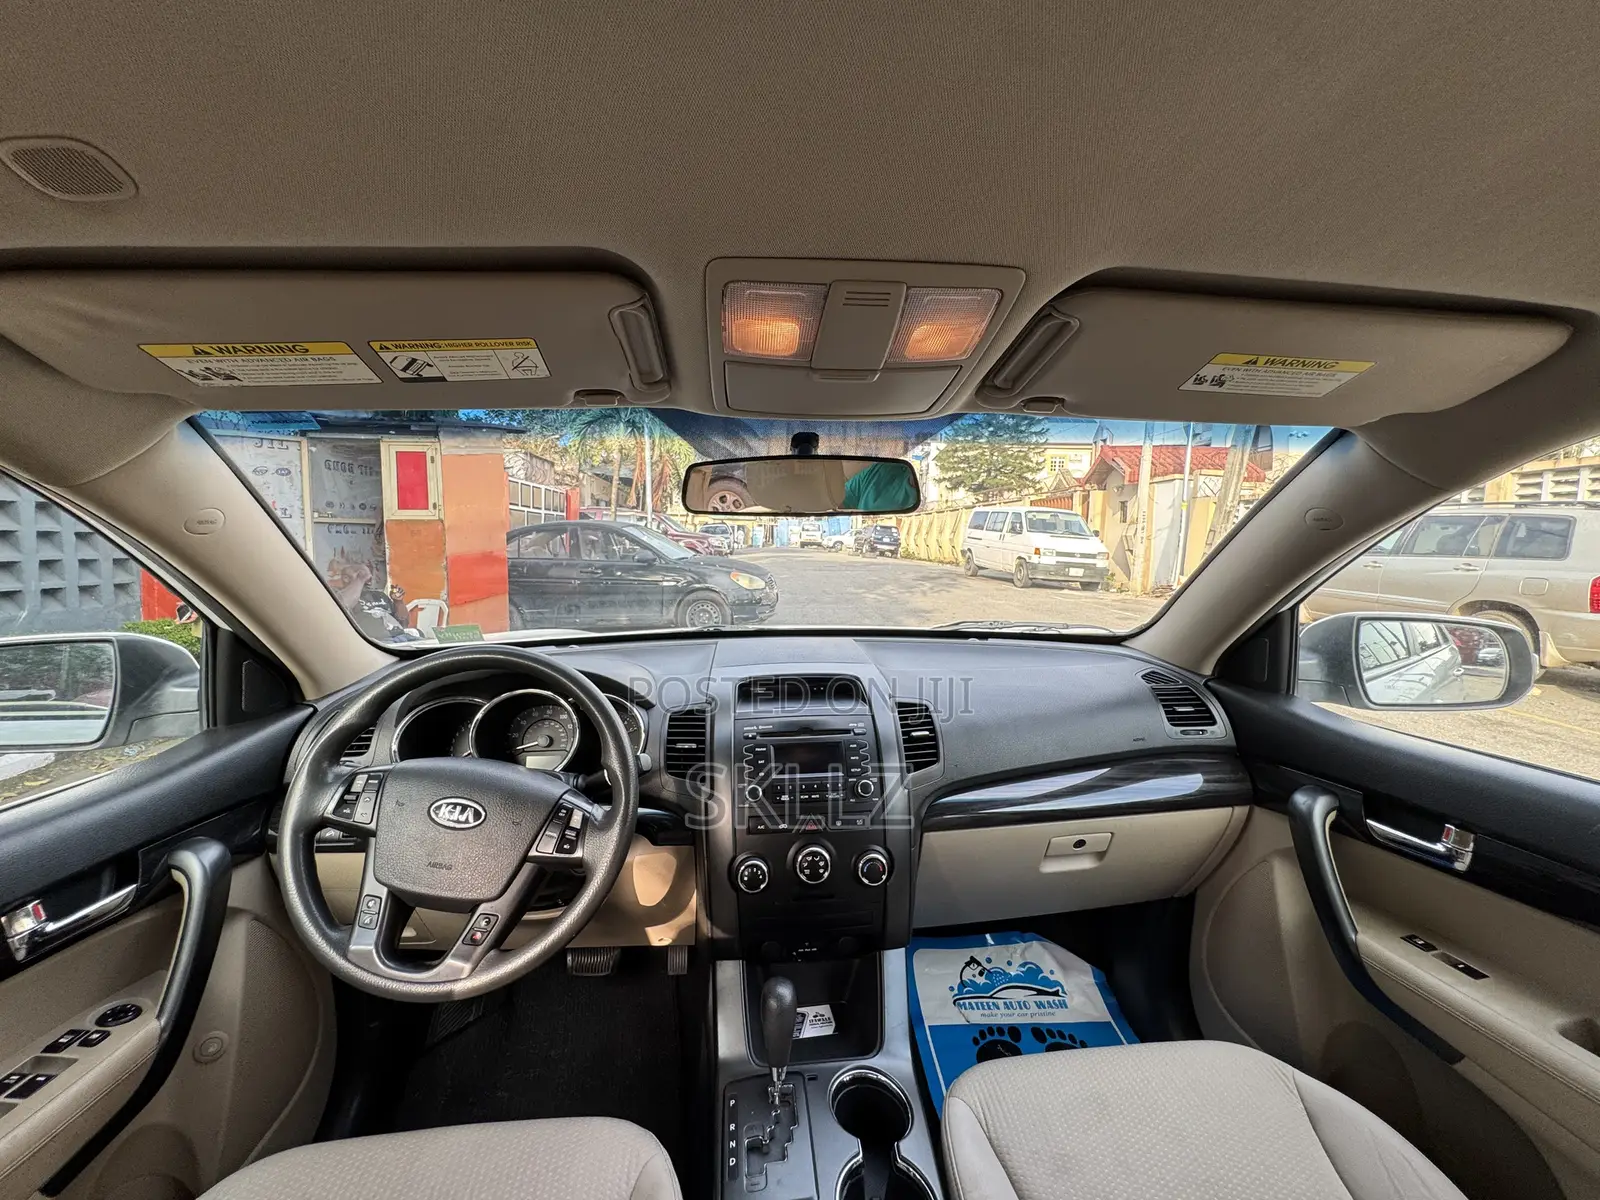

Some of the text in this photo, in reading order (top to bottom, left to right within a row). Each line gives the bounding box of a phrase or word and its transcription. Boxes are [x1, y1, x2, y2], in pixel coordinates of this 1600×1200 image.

[211, 344, 310, 356] WARNING
[1264, 358, 1339, 369] WARNING
[426, 861, 453, 871] AIRBAG
[957, 1000, 1069, 1012] MATEEN AUTO WASH
[980, 1011, 998, 1019] make
[999, 1011, 1016, 1019] your
[1030, 1010, 1056, 1019] pristine
[729, 1123, 736, 1131] R
[729, 1140, 736, 1149] N
[729, 1157, 737, 1167] D
